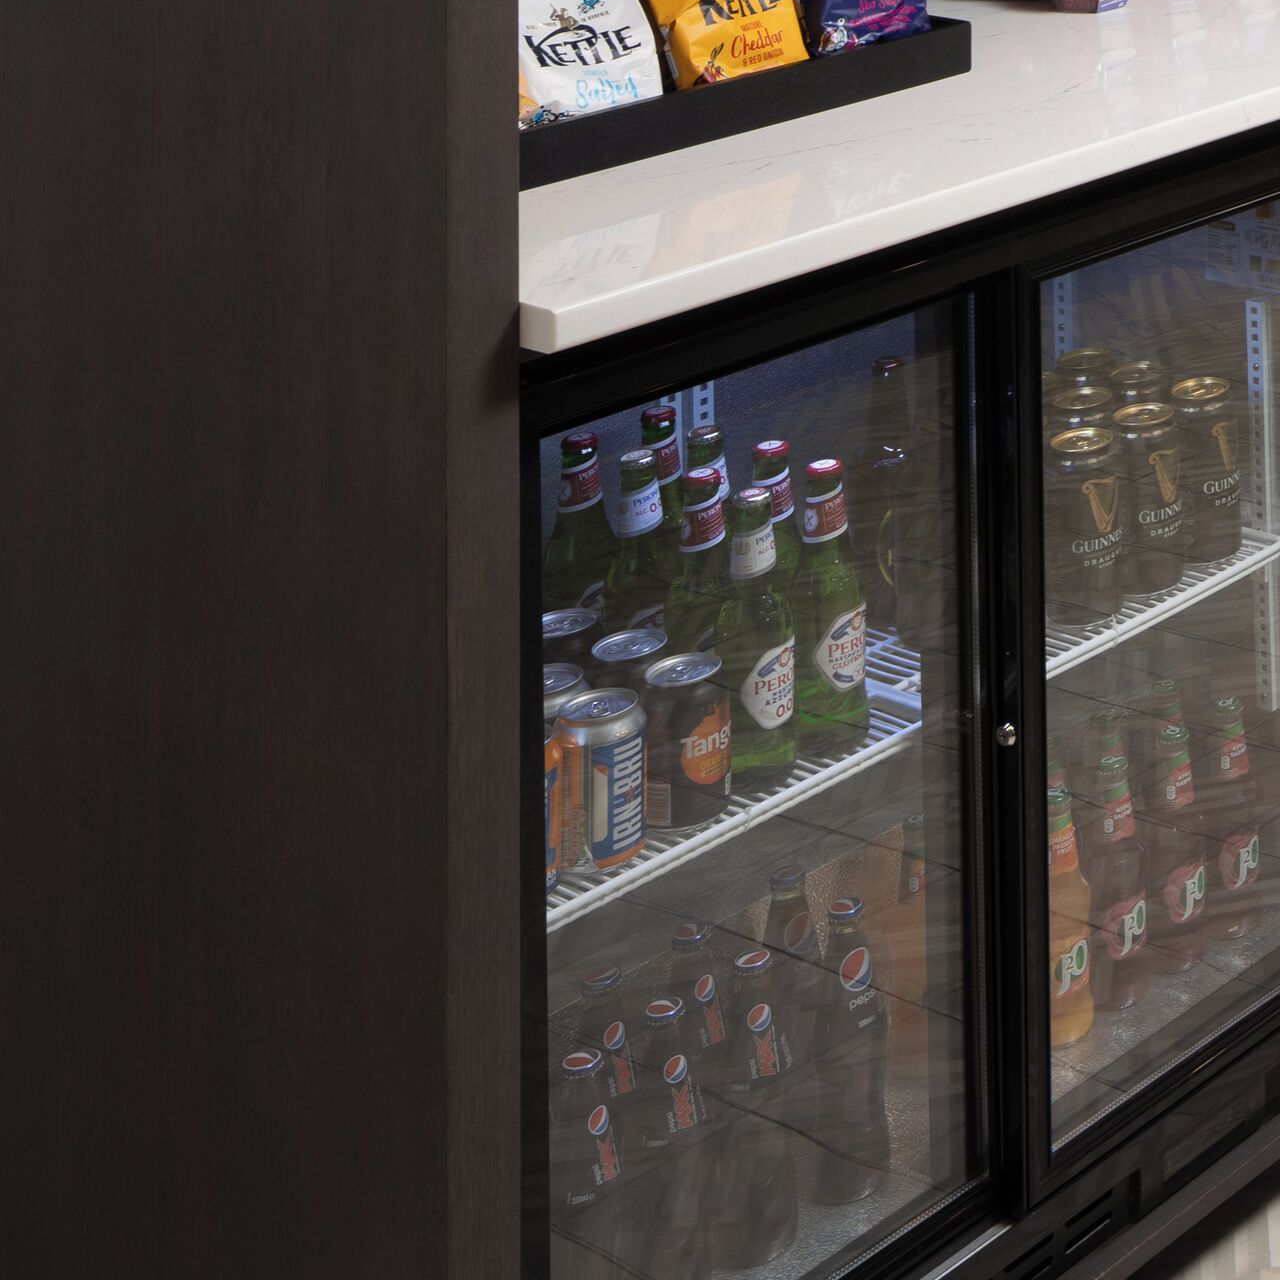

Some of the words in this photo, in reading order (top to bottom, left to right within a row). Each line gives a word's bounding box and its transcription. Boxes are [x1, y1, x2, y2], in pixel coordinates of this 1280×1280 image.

[523, 24, 642, 68] KETTLE
[731, 27, 783, 59] Cheddar
[748, 55, 762, 65] RED
[763, 48, 785, 61] ONION
[575, 75, 639, 110] Salted
[753, 667, 795, 696] PERO
[848, 988, 877, 1012] peps
